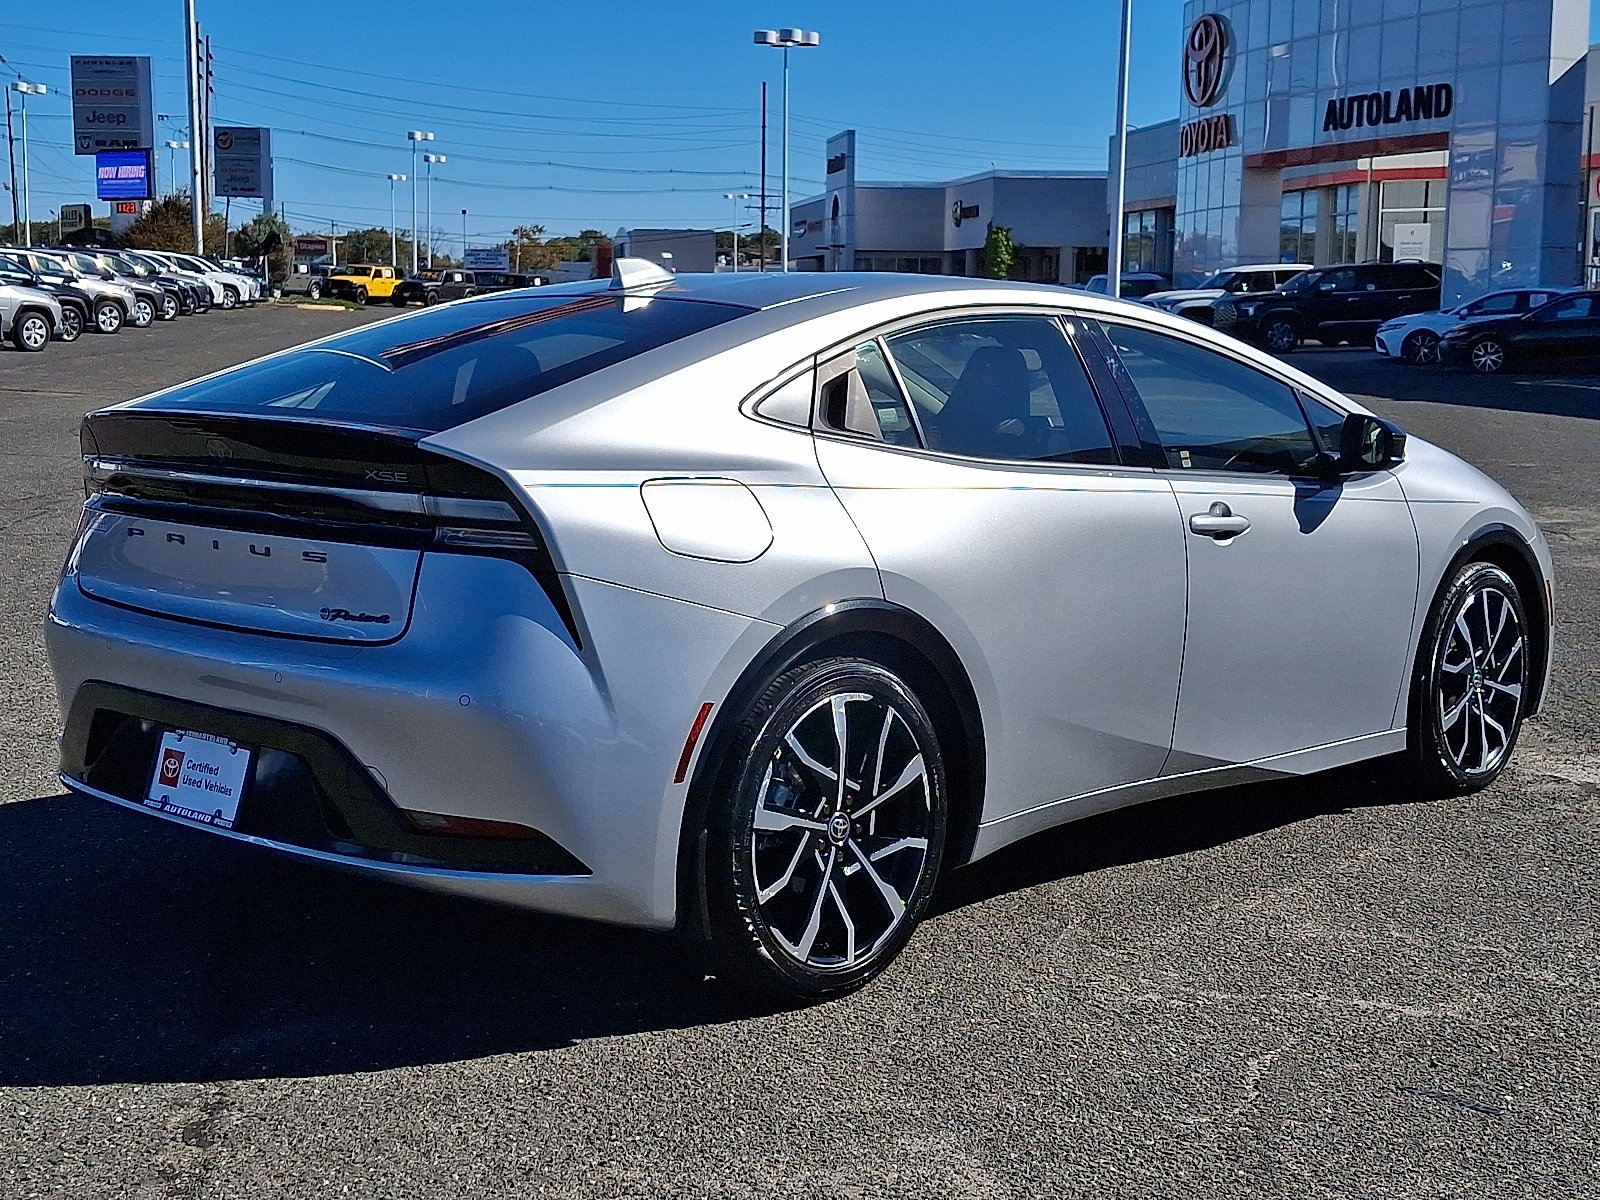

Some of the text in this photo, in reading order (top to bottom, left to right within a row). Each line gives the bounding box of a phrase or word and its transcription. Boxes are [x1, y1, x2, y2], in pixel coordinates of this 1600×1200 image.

[75, 88, 135, 97] DODGE
[1323, 83, 1452, 131] AUTOLAND
[86, 110, 127, 125] Jeep
[95, 139, 138, 147] RAM
[98, 165, 145, 179] NOW HIRING
[365, 469, 409, 482] XSE
[127, 527, 327, 563] PRIUS
[186, 759, 220, 776] Certified
[182, 775, 233, 796] Used Vehicles
[163, 804, 212, 823] AUTOLAND
